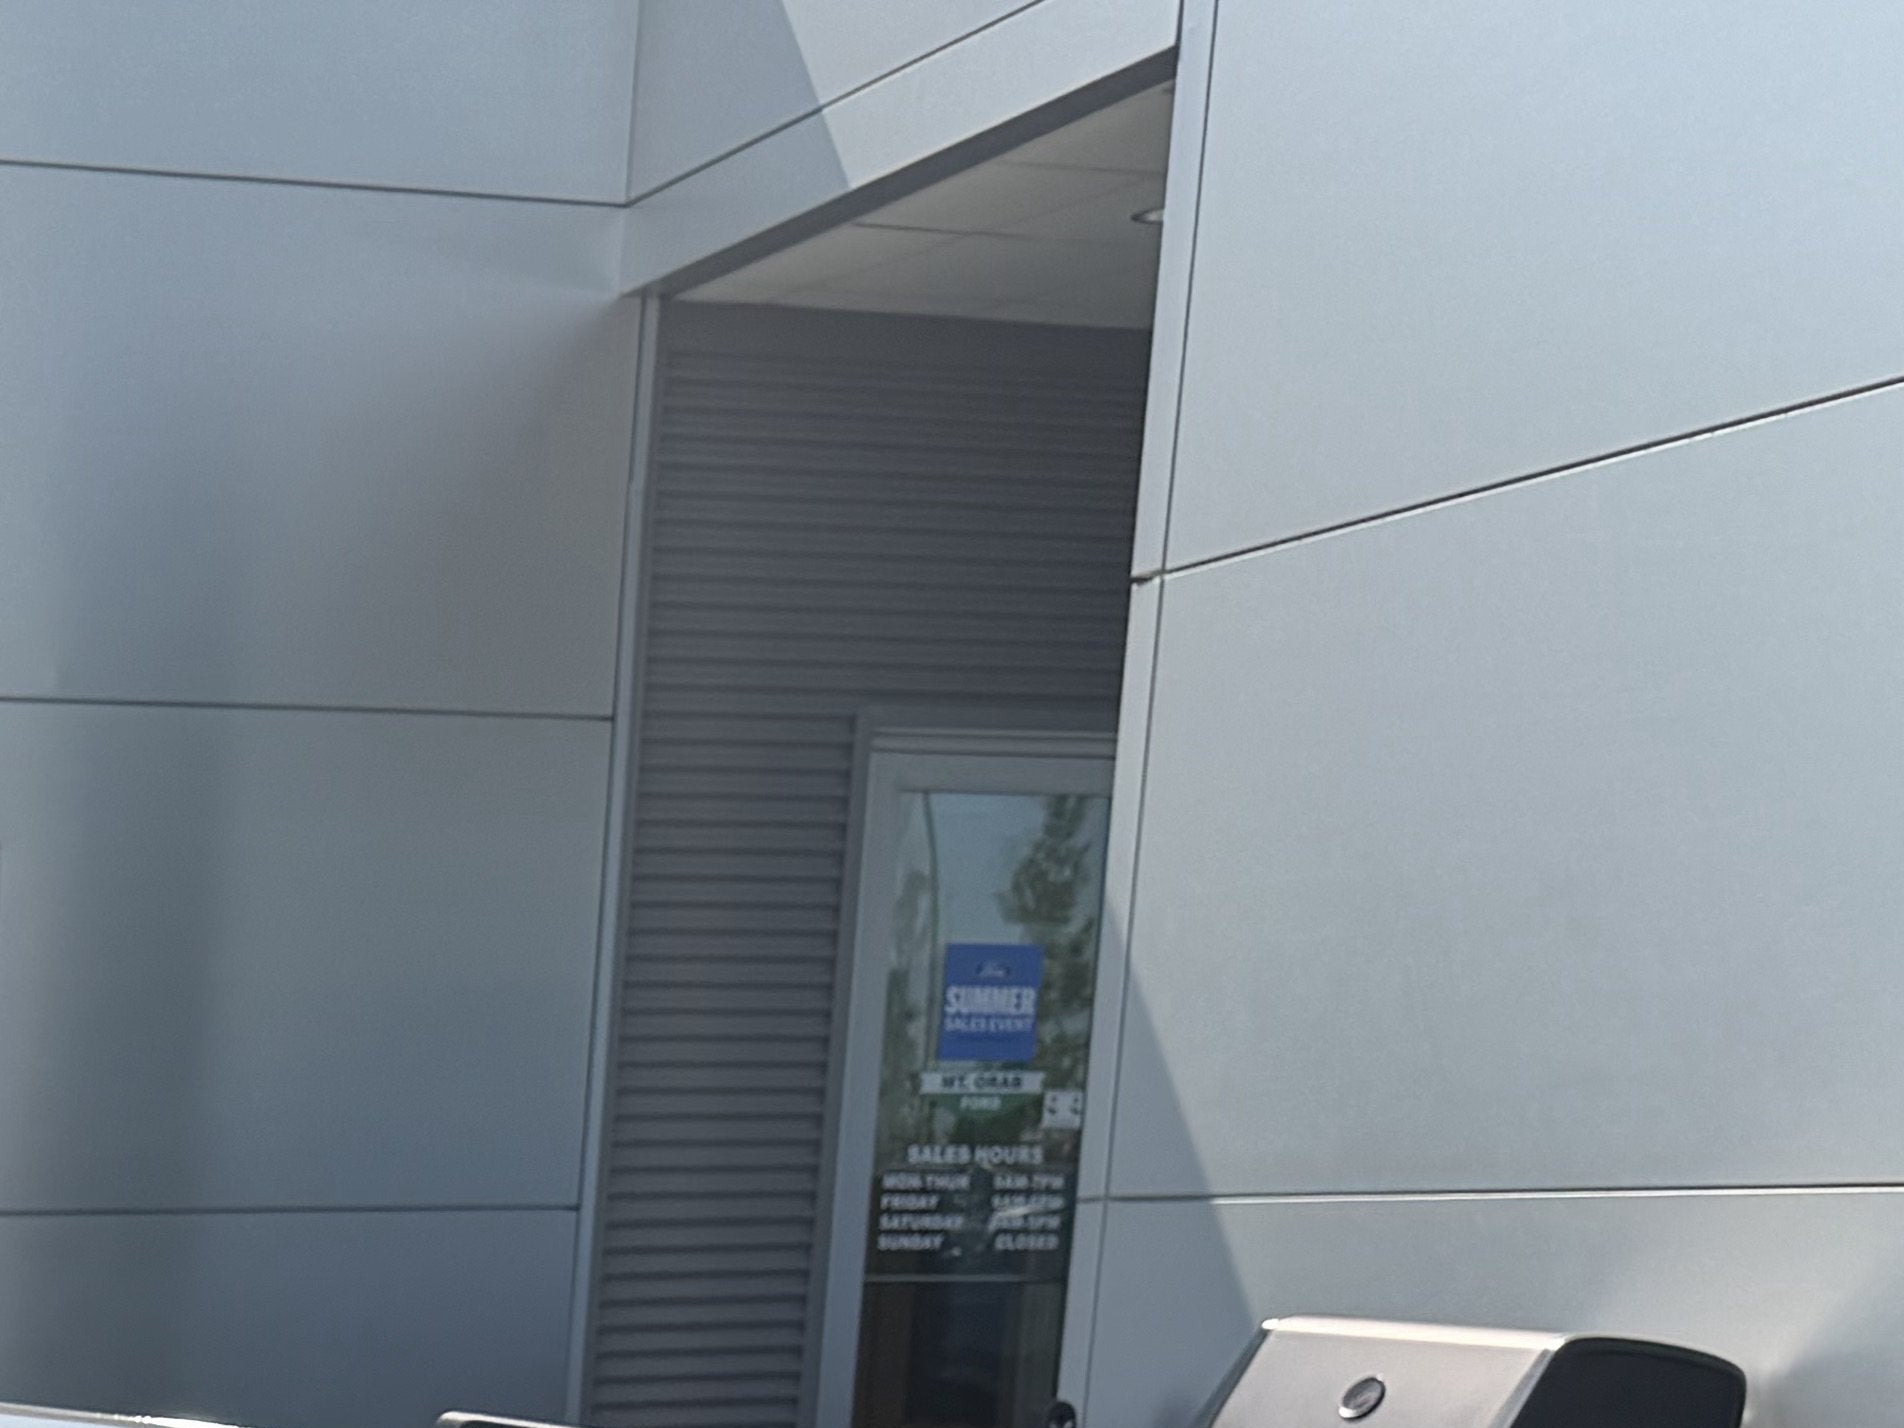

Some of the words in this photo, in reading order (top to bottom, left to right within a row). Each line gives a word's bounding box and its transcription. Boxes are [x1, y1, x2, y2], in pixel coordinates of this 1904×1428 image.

[944, 985, 1036, 1015] SUMMER
[908, 1145, 971, 1164] SALES
[975, 1145, 1043, 1165] HOURS
